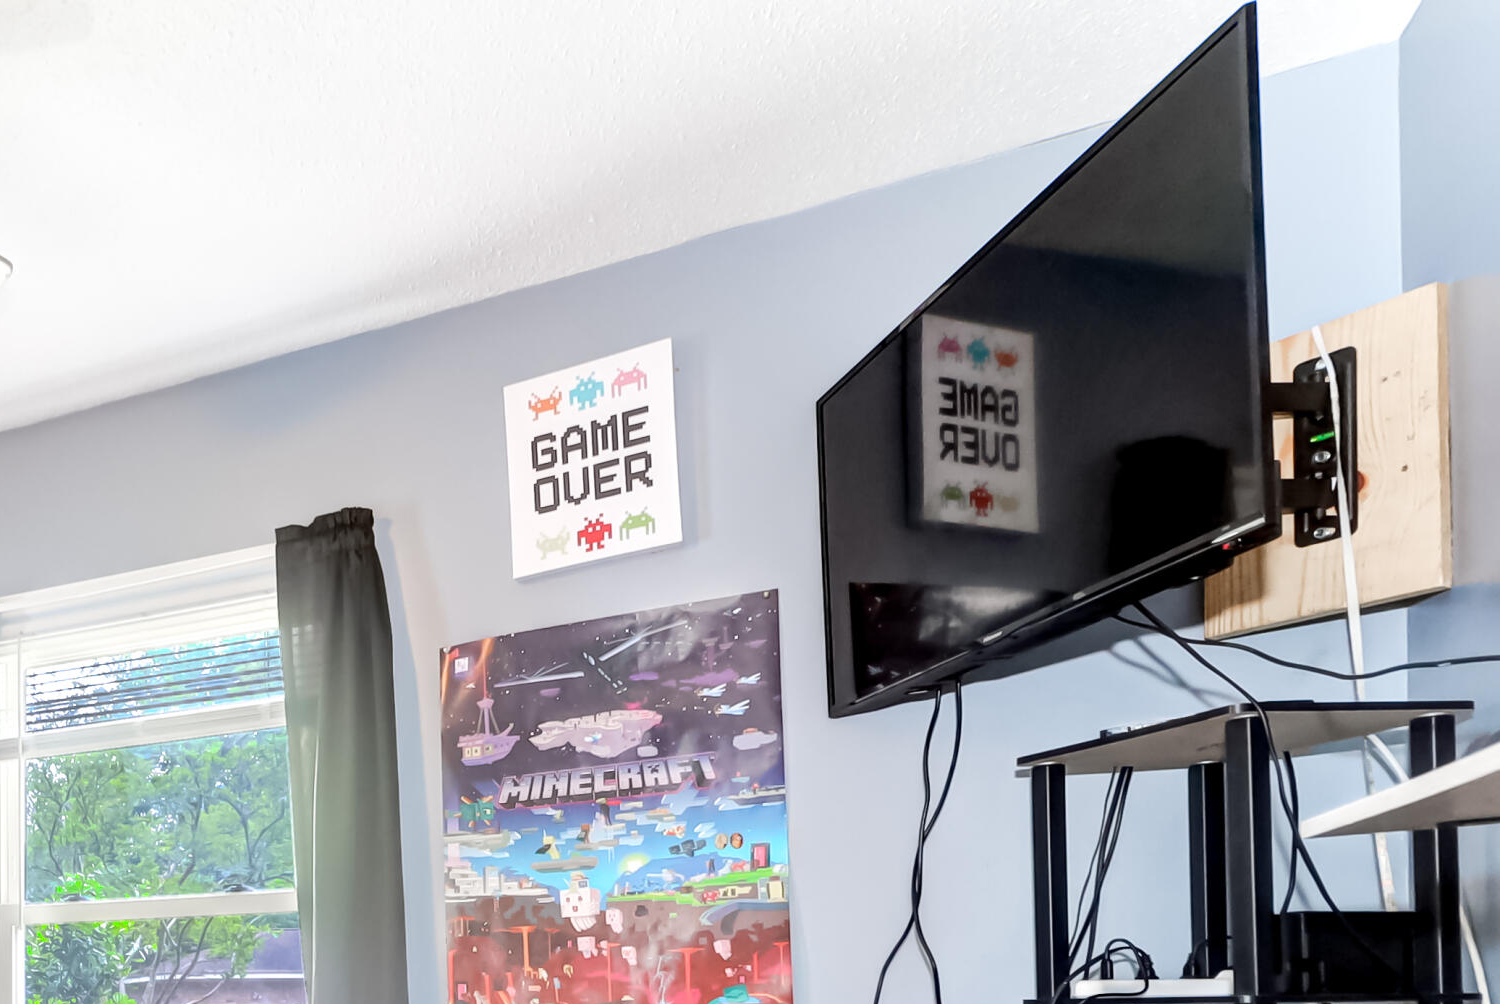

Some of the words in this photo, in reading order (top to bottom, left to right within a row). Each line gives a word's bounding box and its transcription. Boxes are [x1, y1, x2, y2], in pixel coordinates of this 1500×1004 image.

[531, 405, 651, 471] GAME
[534, 451, 653, 515] OVER
[499, 754, 716, 807] MINECRAFT
